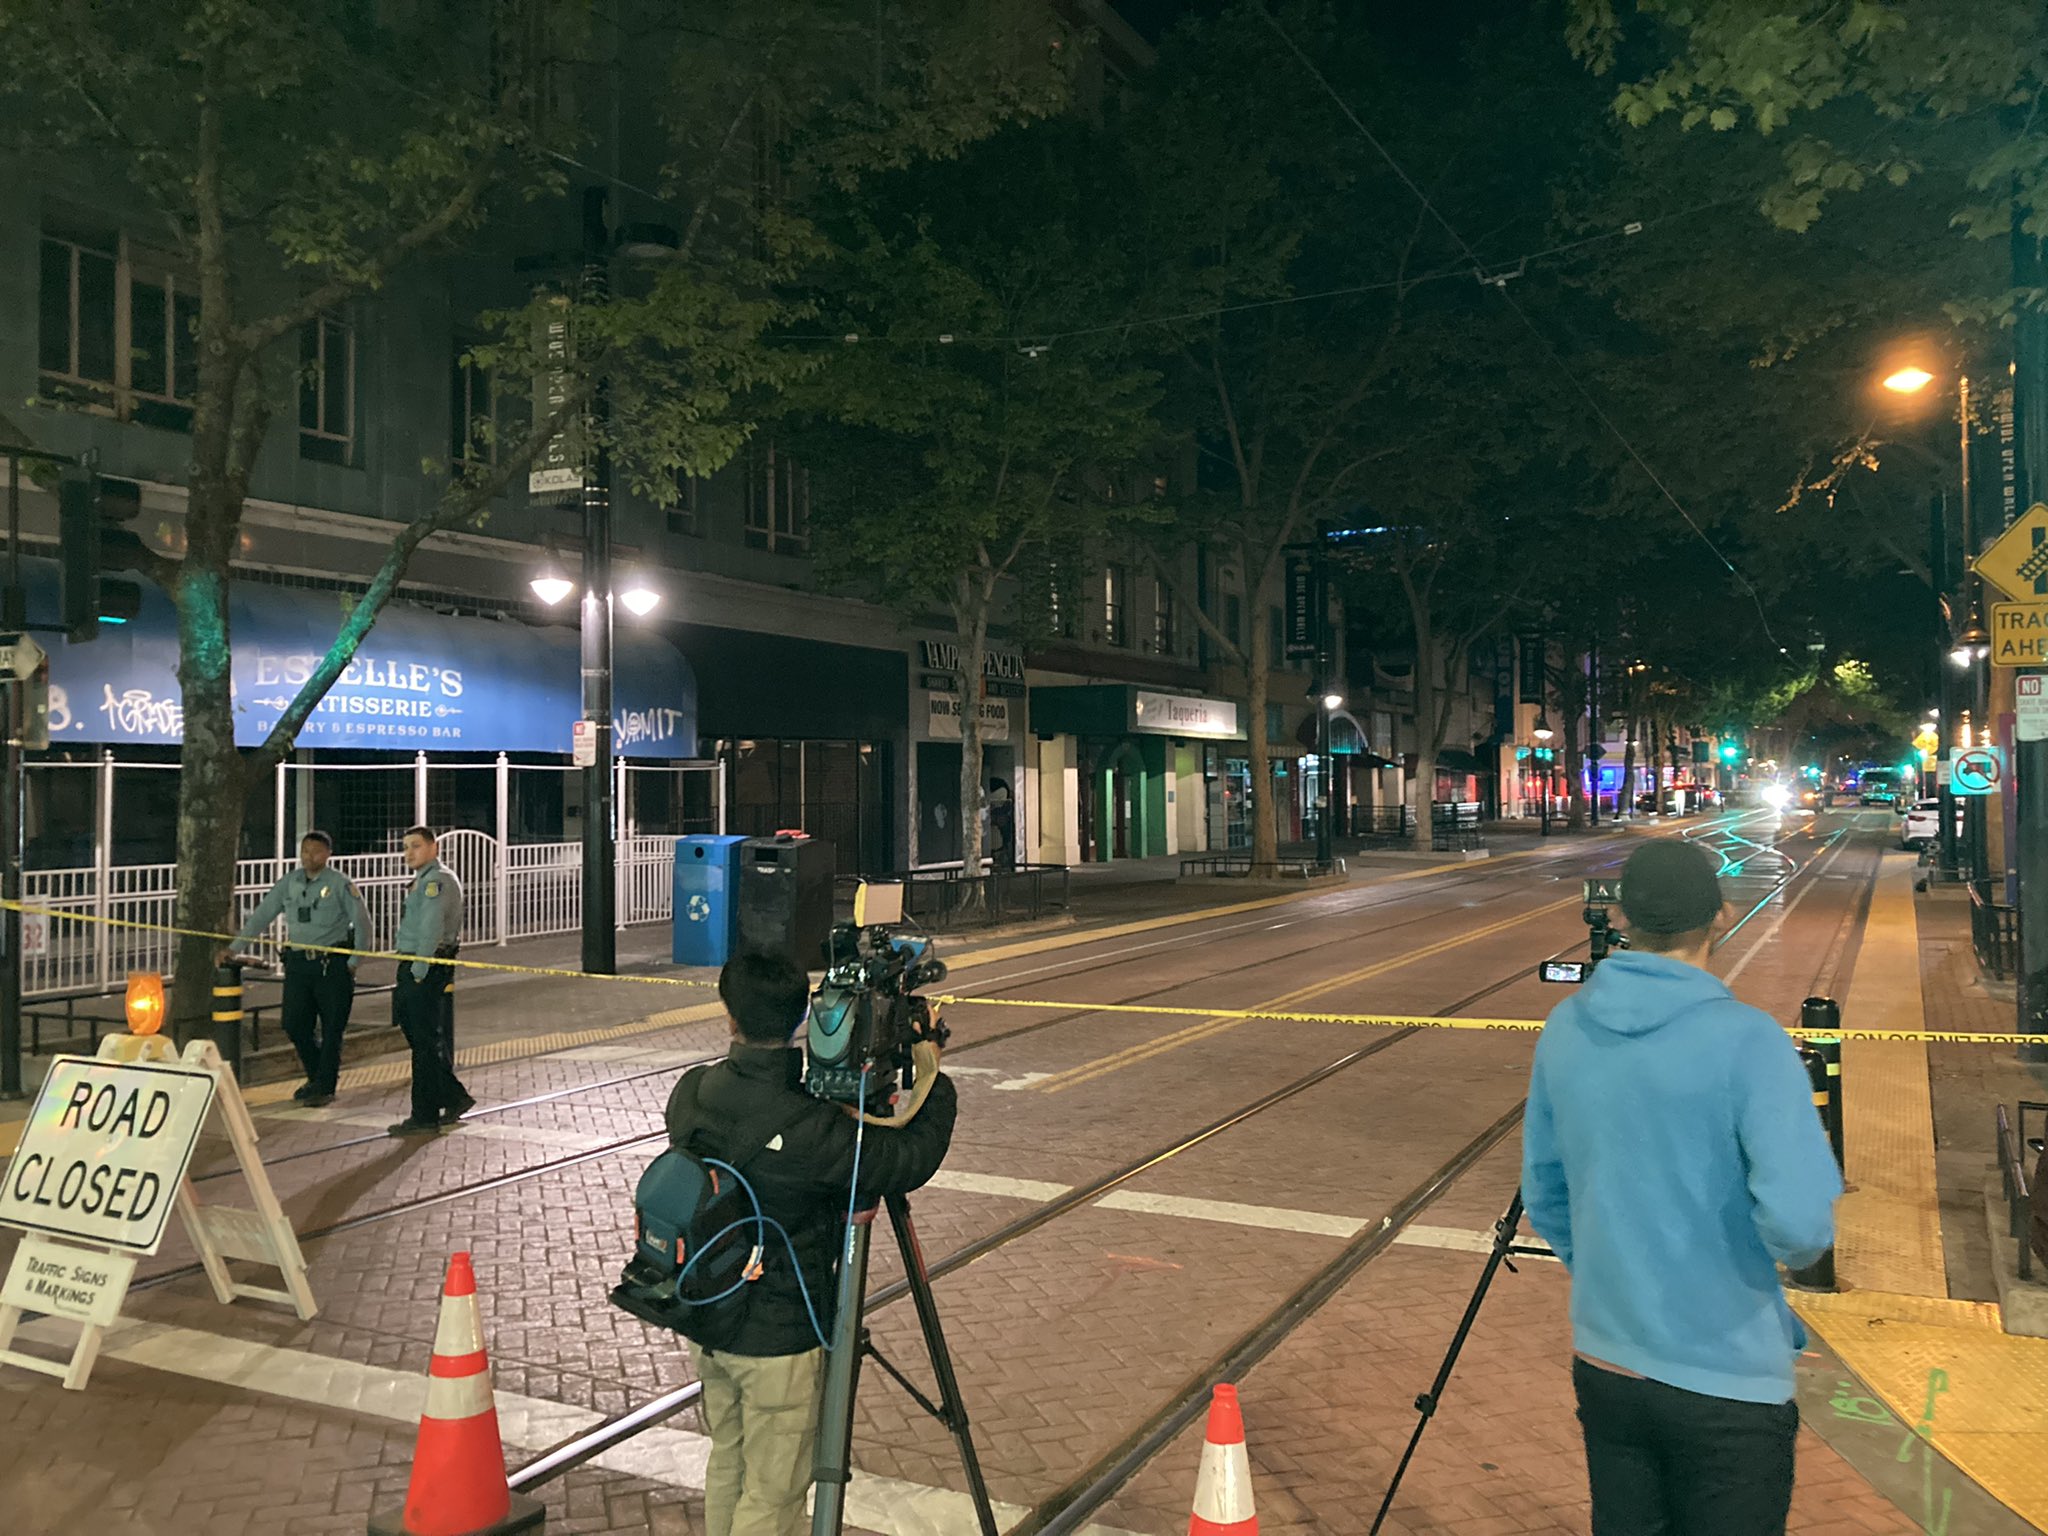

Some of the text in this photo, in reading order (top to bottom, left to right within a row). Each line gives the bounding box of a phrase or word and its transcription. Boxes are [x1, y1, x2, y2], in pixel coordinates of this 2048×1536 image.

[2021, 679, 2039, 694] NO
[931, 699, 950, 716] NOW
[986, 704, 1006, 719] FOOD
[1166, 699, 1208, 726] Taqueria
[345, 723, 428, 737] ESPRESSO
[432, 726, 462, 738] BAR
[60, 1081, 170, 1139] ROAD
[13, 1153, 160, 1222] CLOSED
